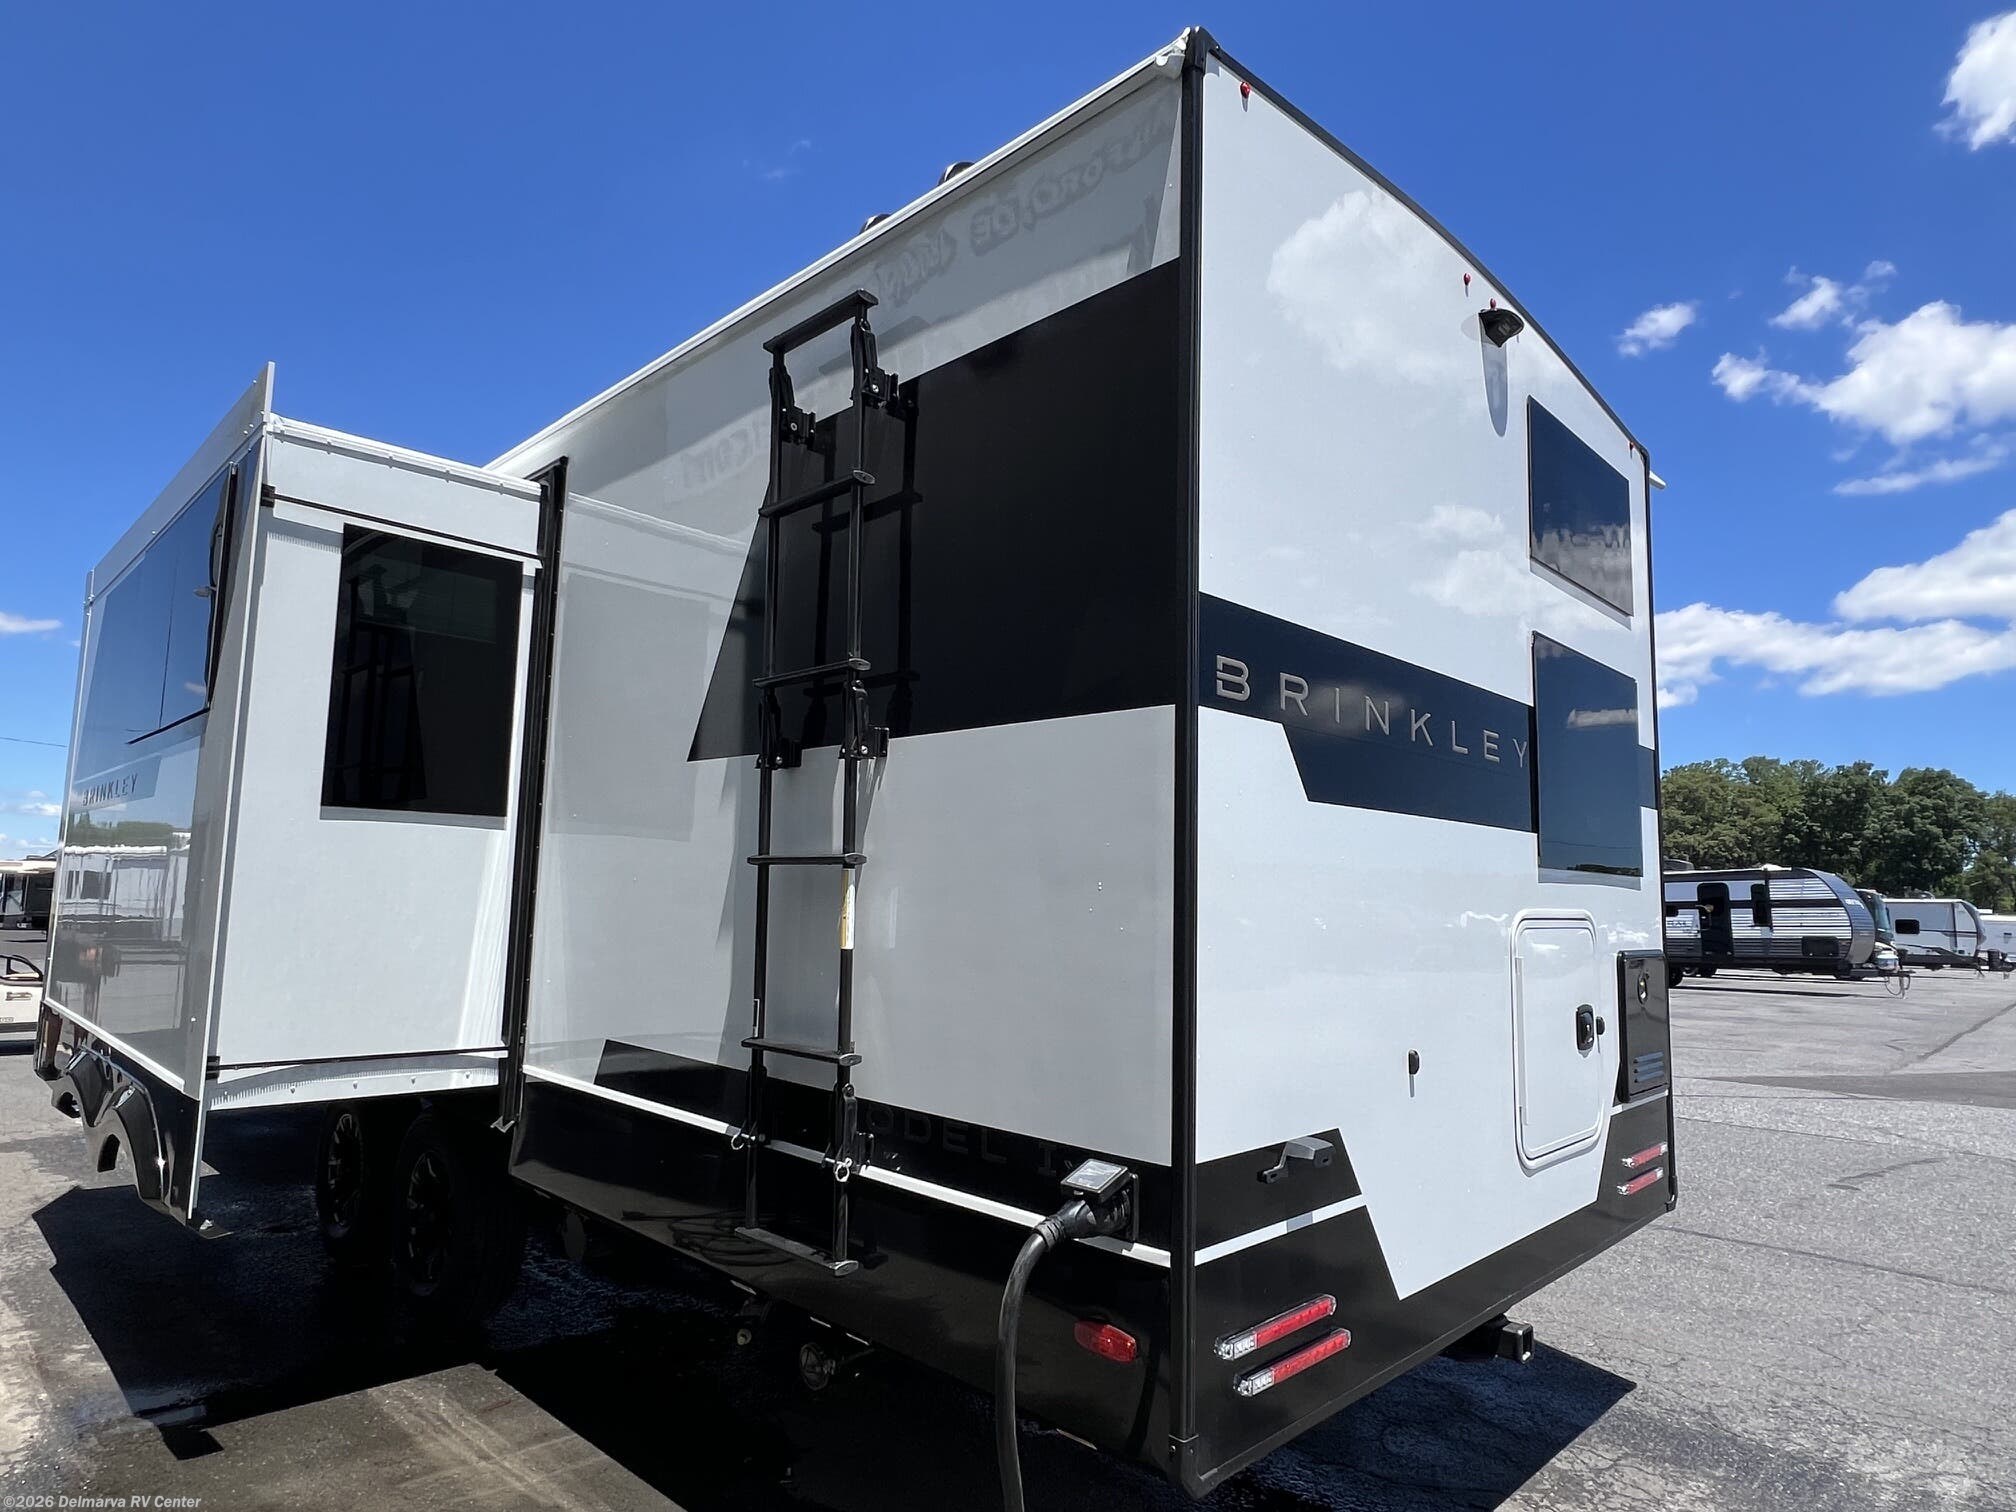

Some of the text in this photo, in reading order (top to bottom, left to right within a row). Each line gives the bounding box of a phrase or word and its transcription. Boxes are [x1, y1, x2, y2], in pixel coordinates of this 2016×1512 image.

[1215, 654, 1528, 768] BRINKLEY
[82, 773, 138, 806] BRINKLEY
[852, 1102, 1008, 1164] ODEL
